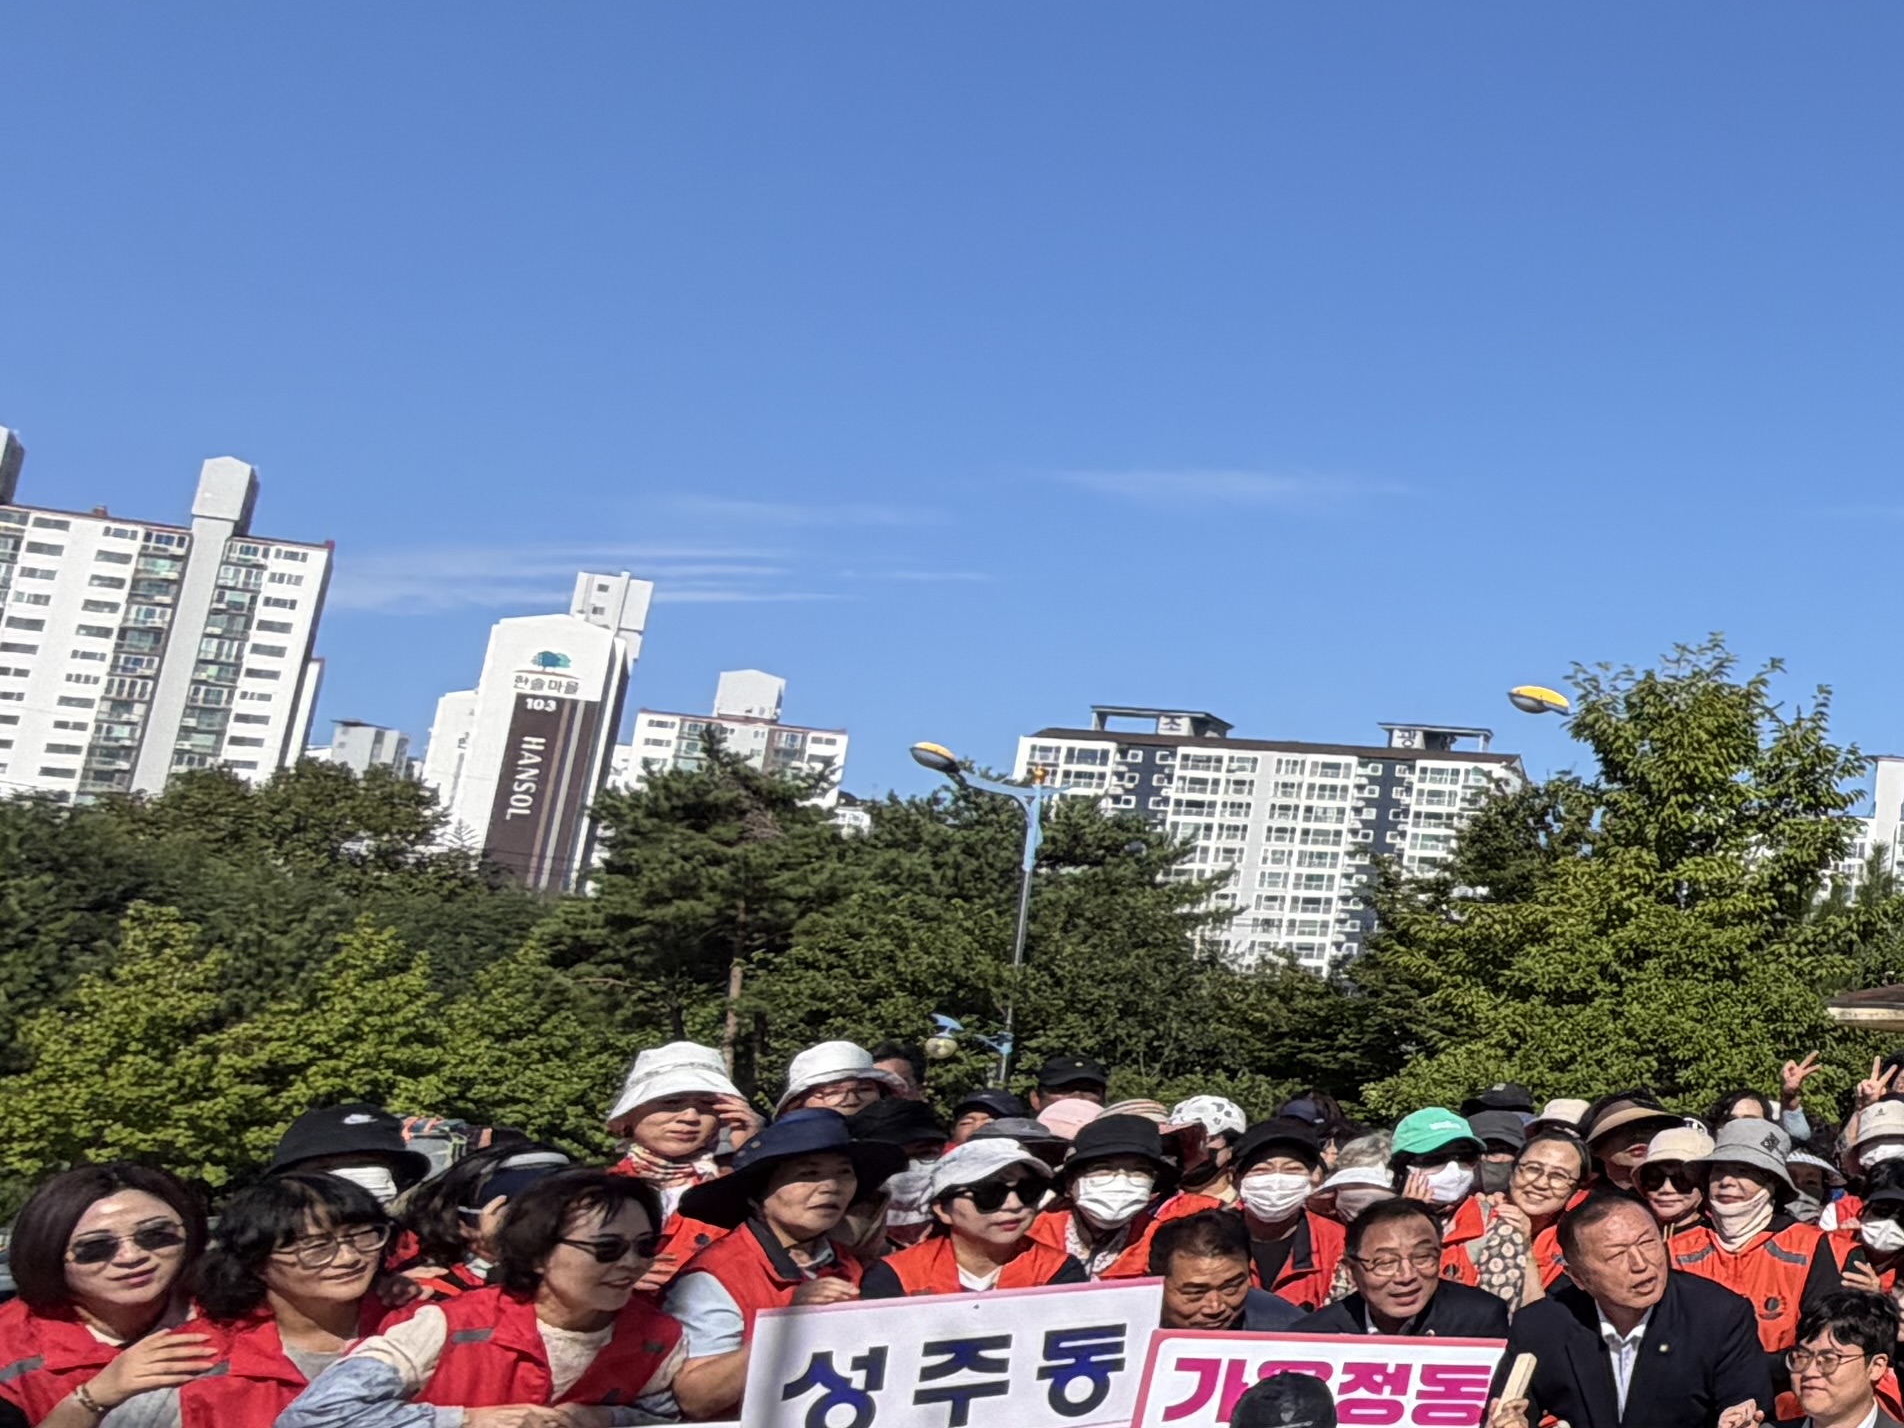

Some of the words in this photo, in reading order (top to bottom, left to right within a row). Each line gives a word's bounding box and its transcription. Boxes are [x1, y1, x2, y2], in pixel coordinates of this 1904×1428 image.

[513, 675, 580, 695] 한솔마을
[525, 697, 557, 712] 103
[505, 735, 547, 821] HANSOL
[1161, 1357, 1493, 1427] 가정동
